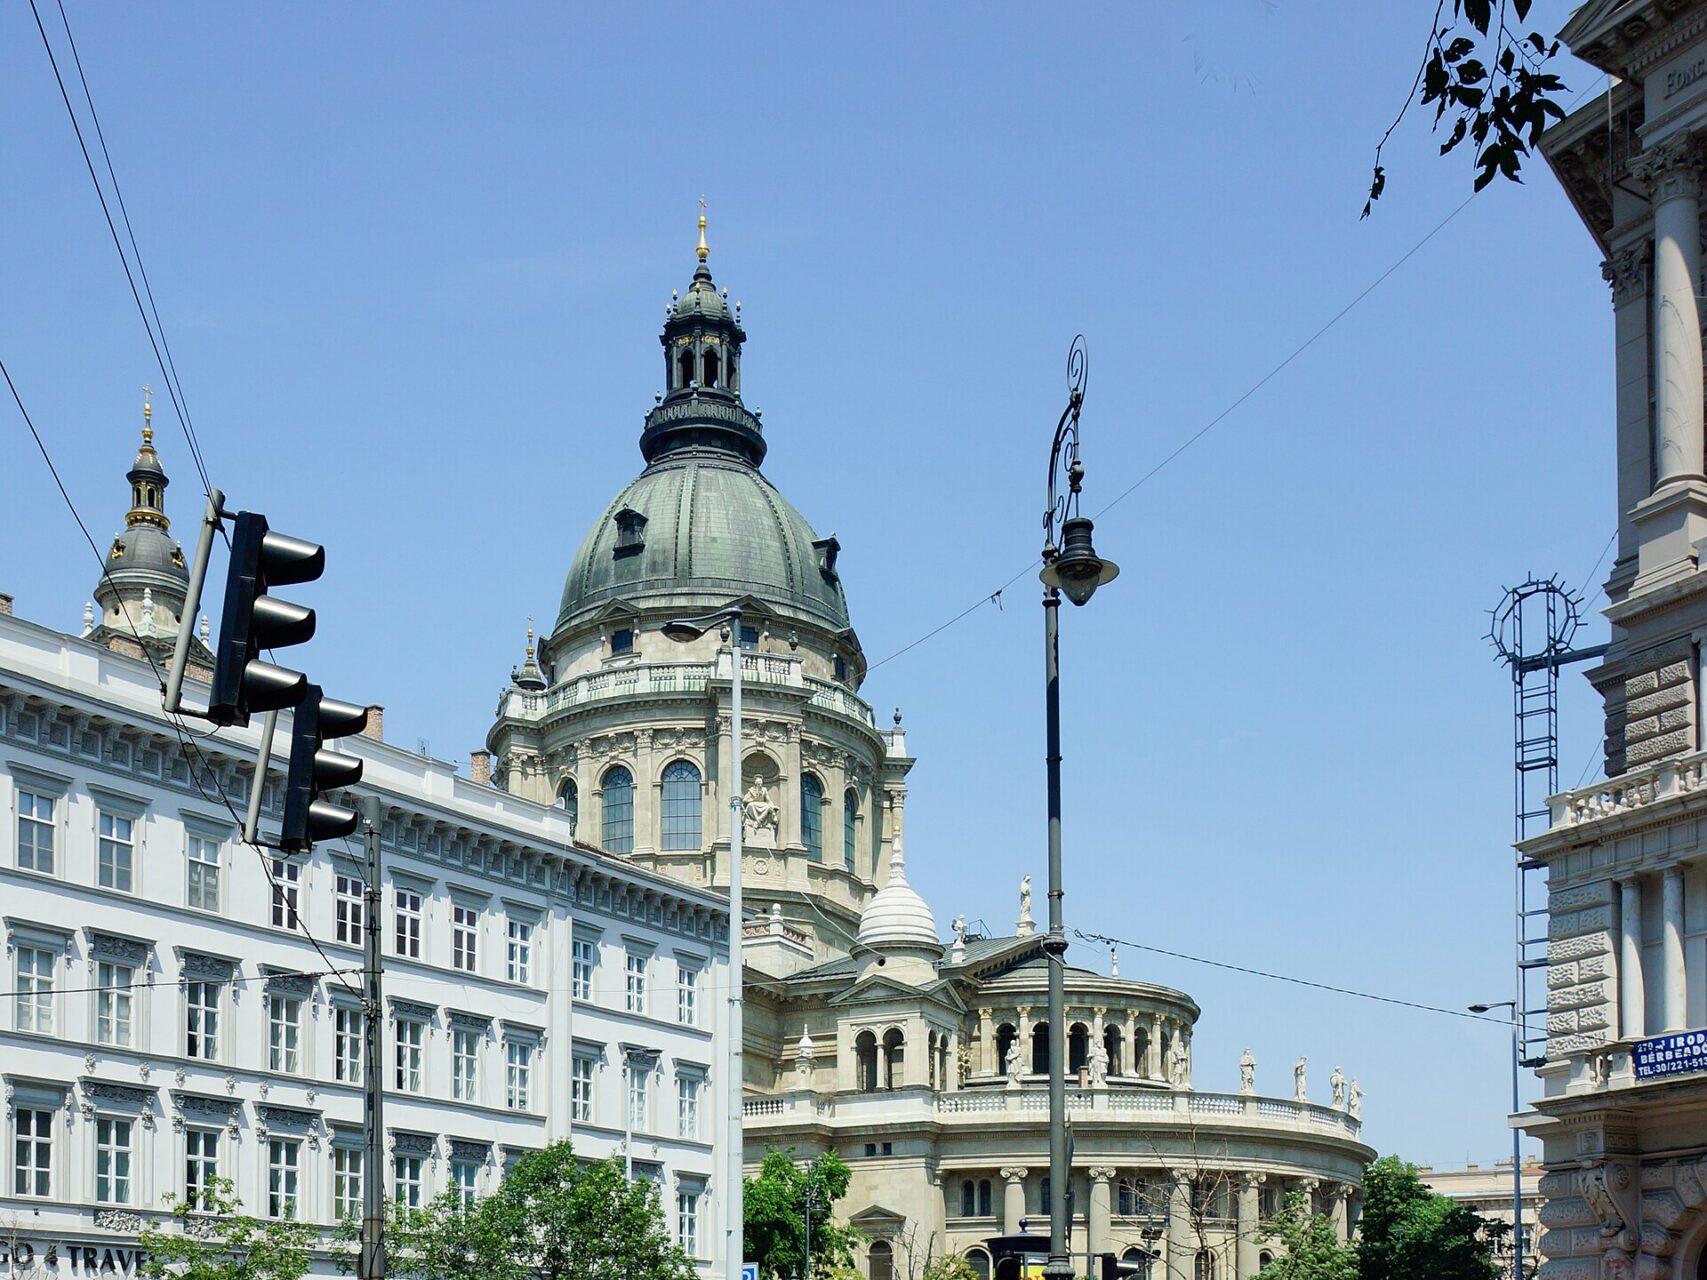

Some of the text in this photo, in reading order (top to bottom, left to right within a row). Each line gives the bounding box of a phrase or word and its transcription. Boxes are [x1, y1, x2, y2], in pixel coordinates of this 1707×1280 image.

[1664, 57, 1707, 98] FONC
[1669, 1034, 1707, 1048] IROD
[66, 1246, 148, 1271] TRAVE
